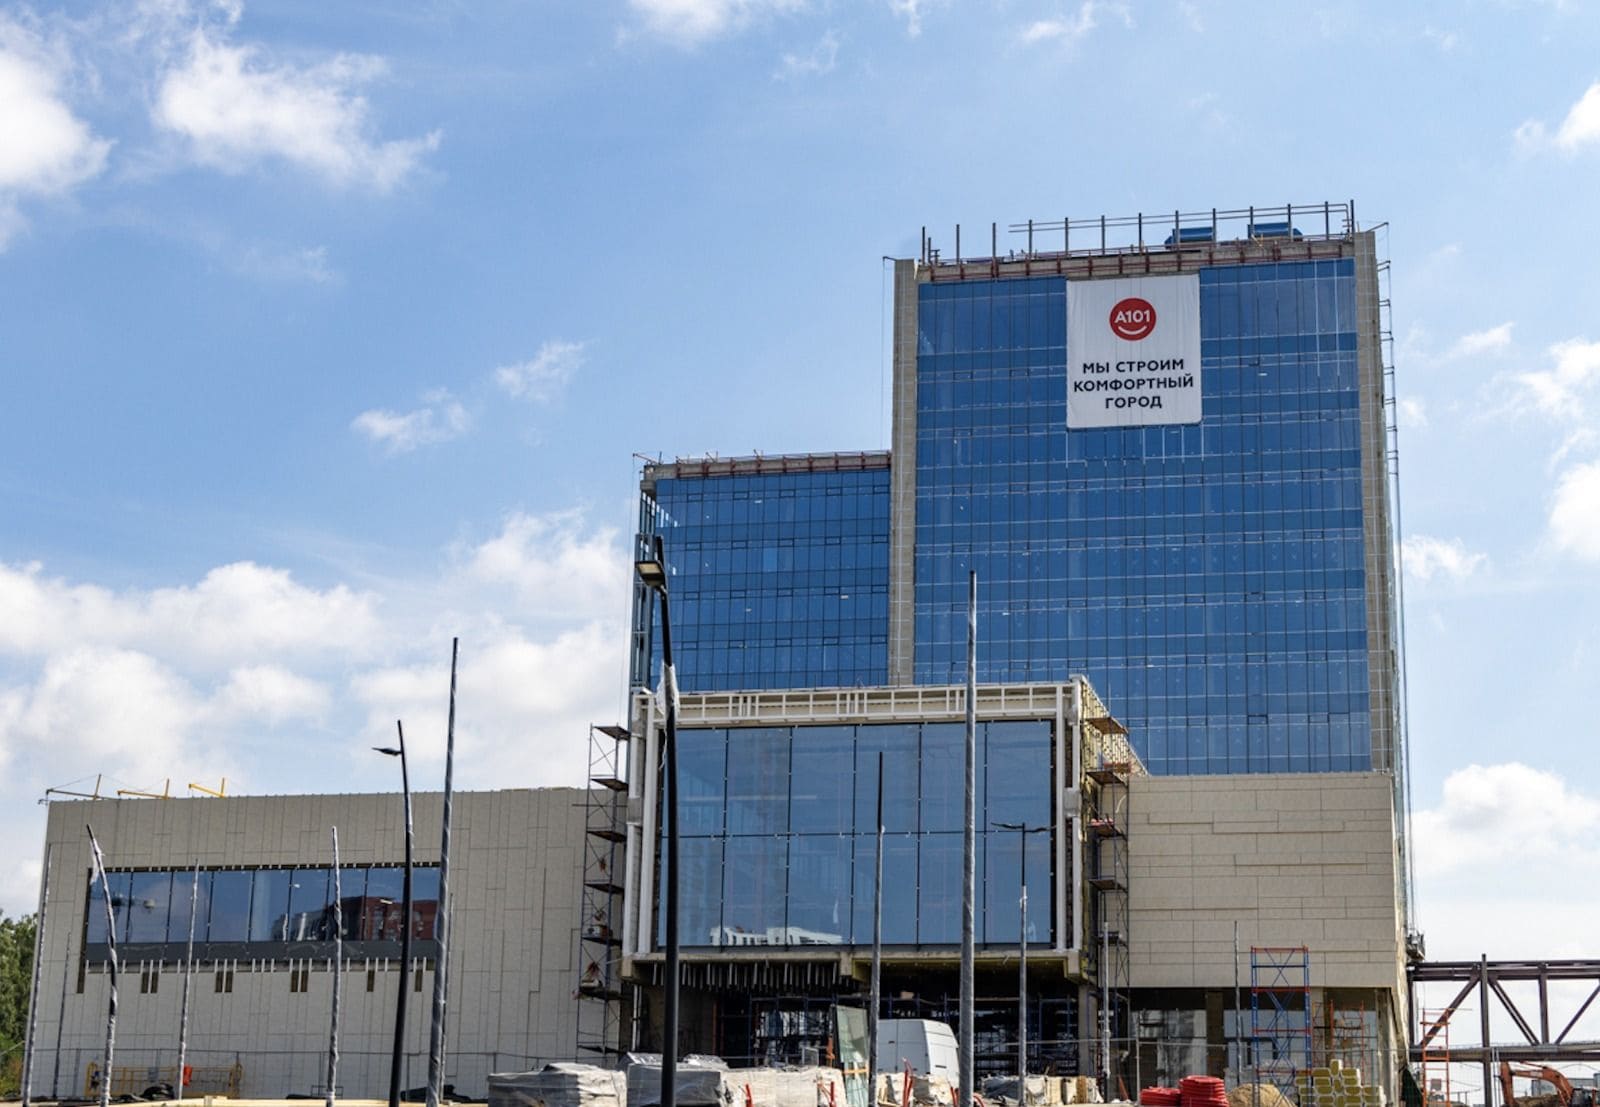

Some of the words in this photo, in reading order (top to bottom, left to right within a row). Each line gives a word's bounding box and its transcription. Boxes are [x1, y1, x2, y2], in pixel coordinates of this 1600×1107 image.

[1114, 309, 1151, 324] А101
[1082, 362, 1110, 374] МЫ
[1116, 358, 1184, 373] СТРОИМ
[1073, 373, 1194, 392] КОМФОРТНЫЙ
[1105, 395, 1162, 409] ГОРОД
